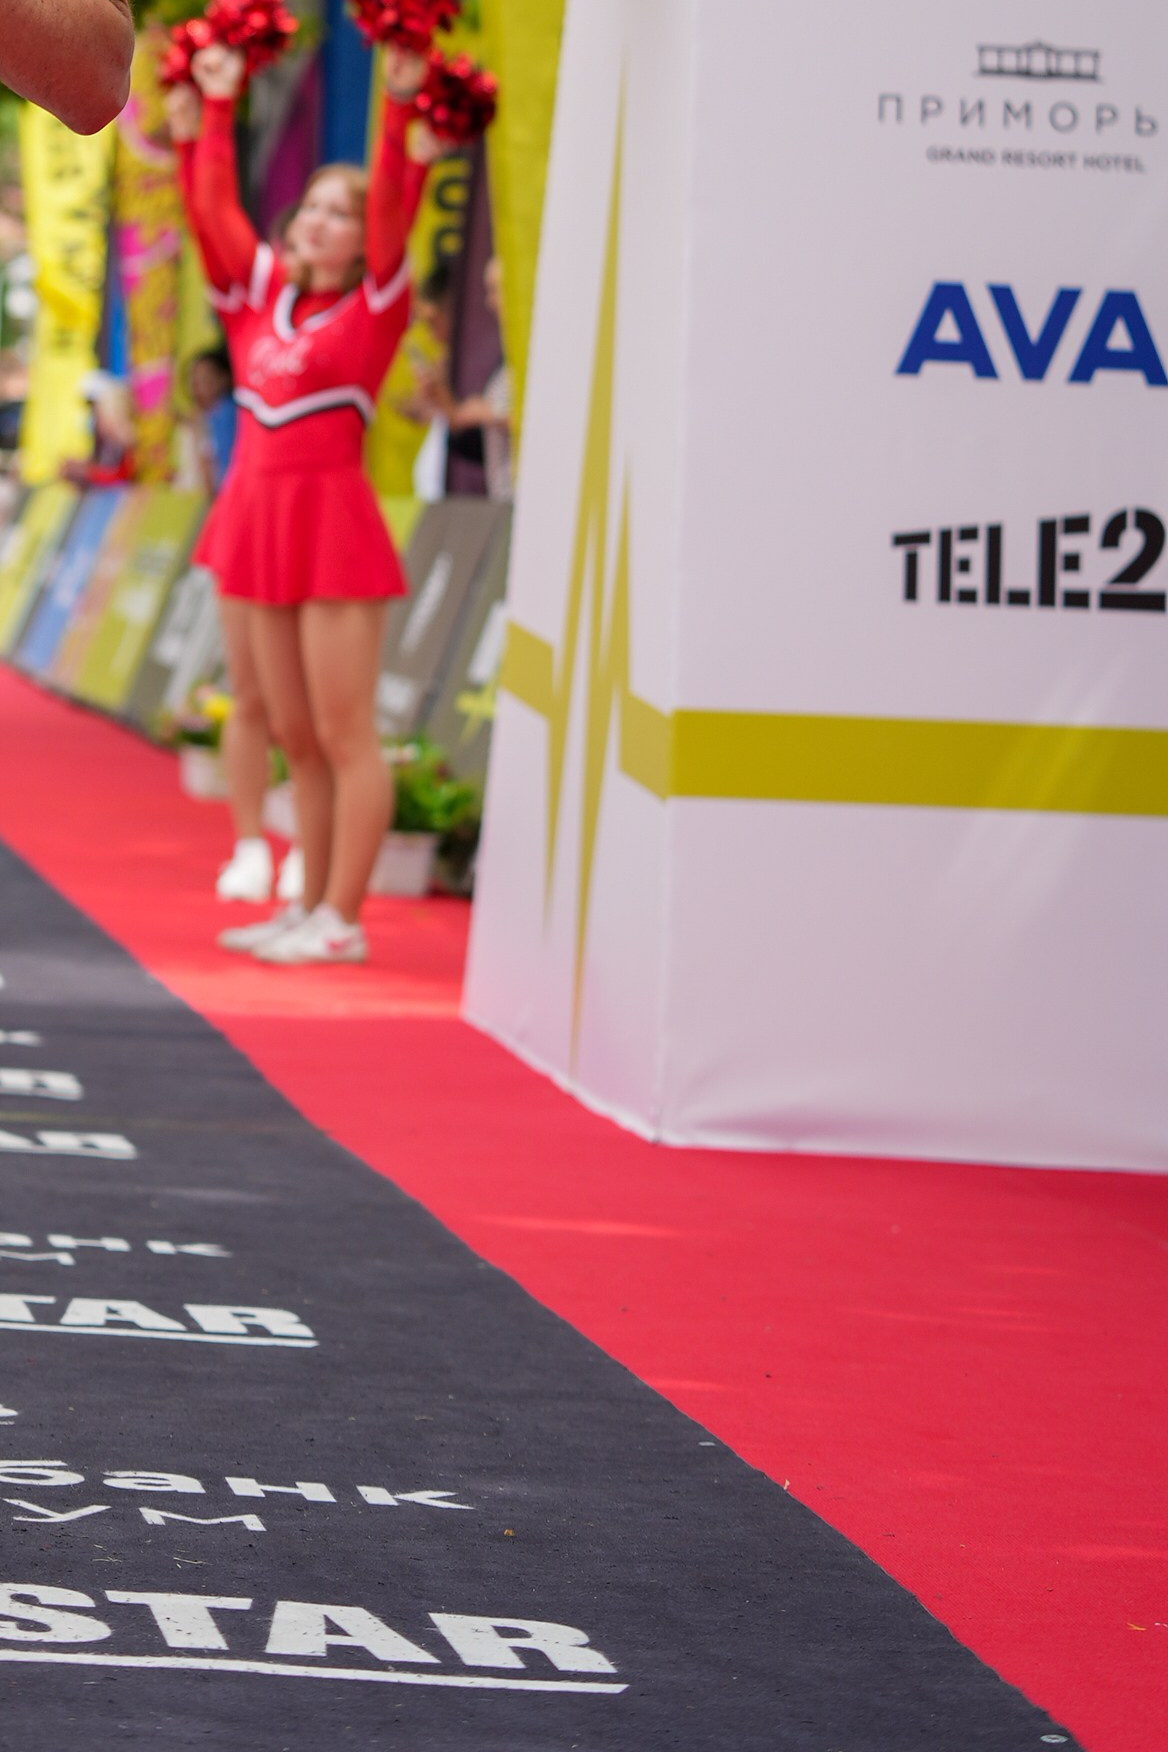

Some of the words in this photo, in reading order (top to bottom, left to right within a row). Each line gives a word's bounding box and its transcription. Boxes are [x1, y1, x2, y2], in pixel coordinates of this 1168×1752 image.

[877, 92, 1159, 138] ПРИМОРЬ
[926, 146, 995, 166] GRAND
[1001, 149, 1077, 169] RESORT
[1082, 154, 1147, 174] HOTEL
[894, 280, 1168, 387] AVA
[892, 507, 1168, 613] TELE2
